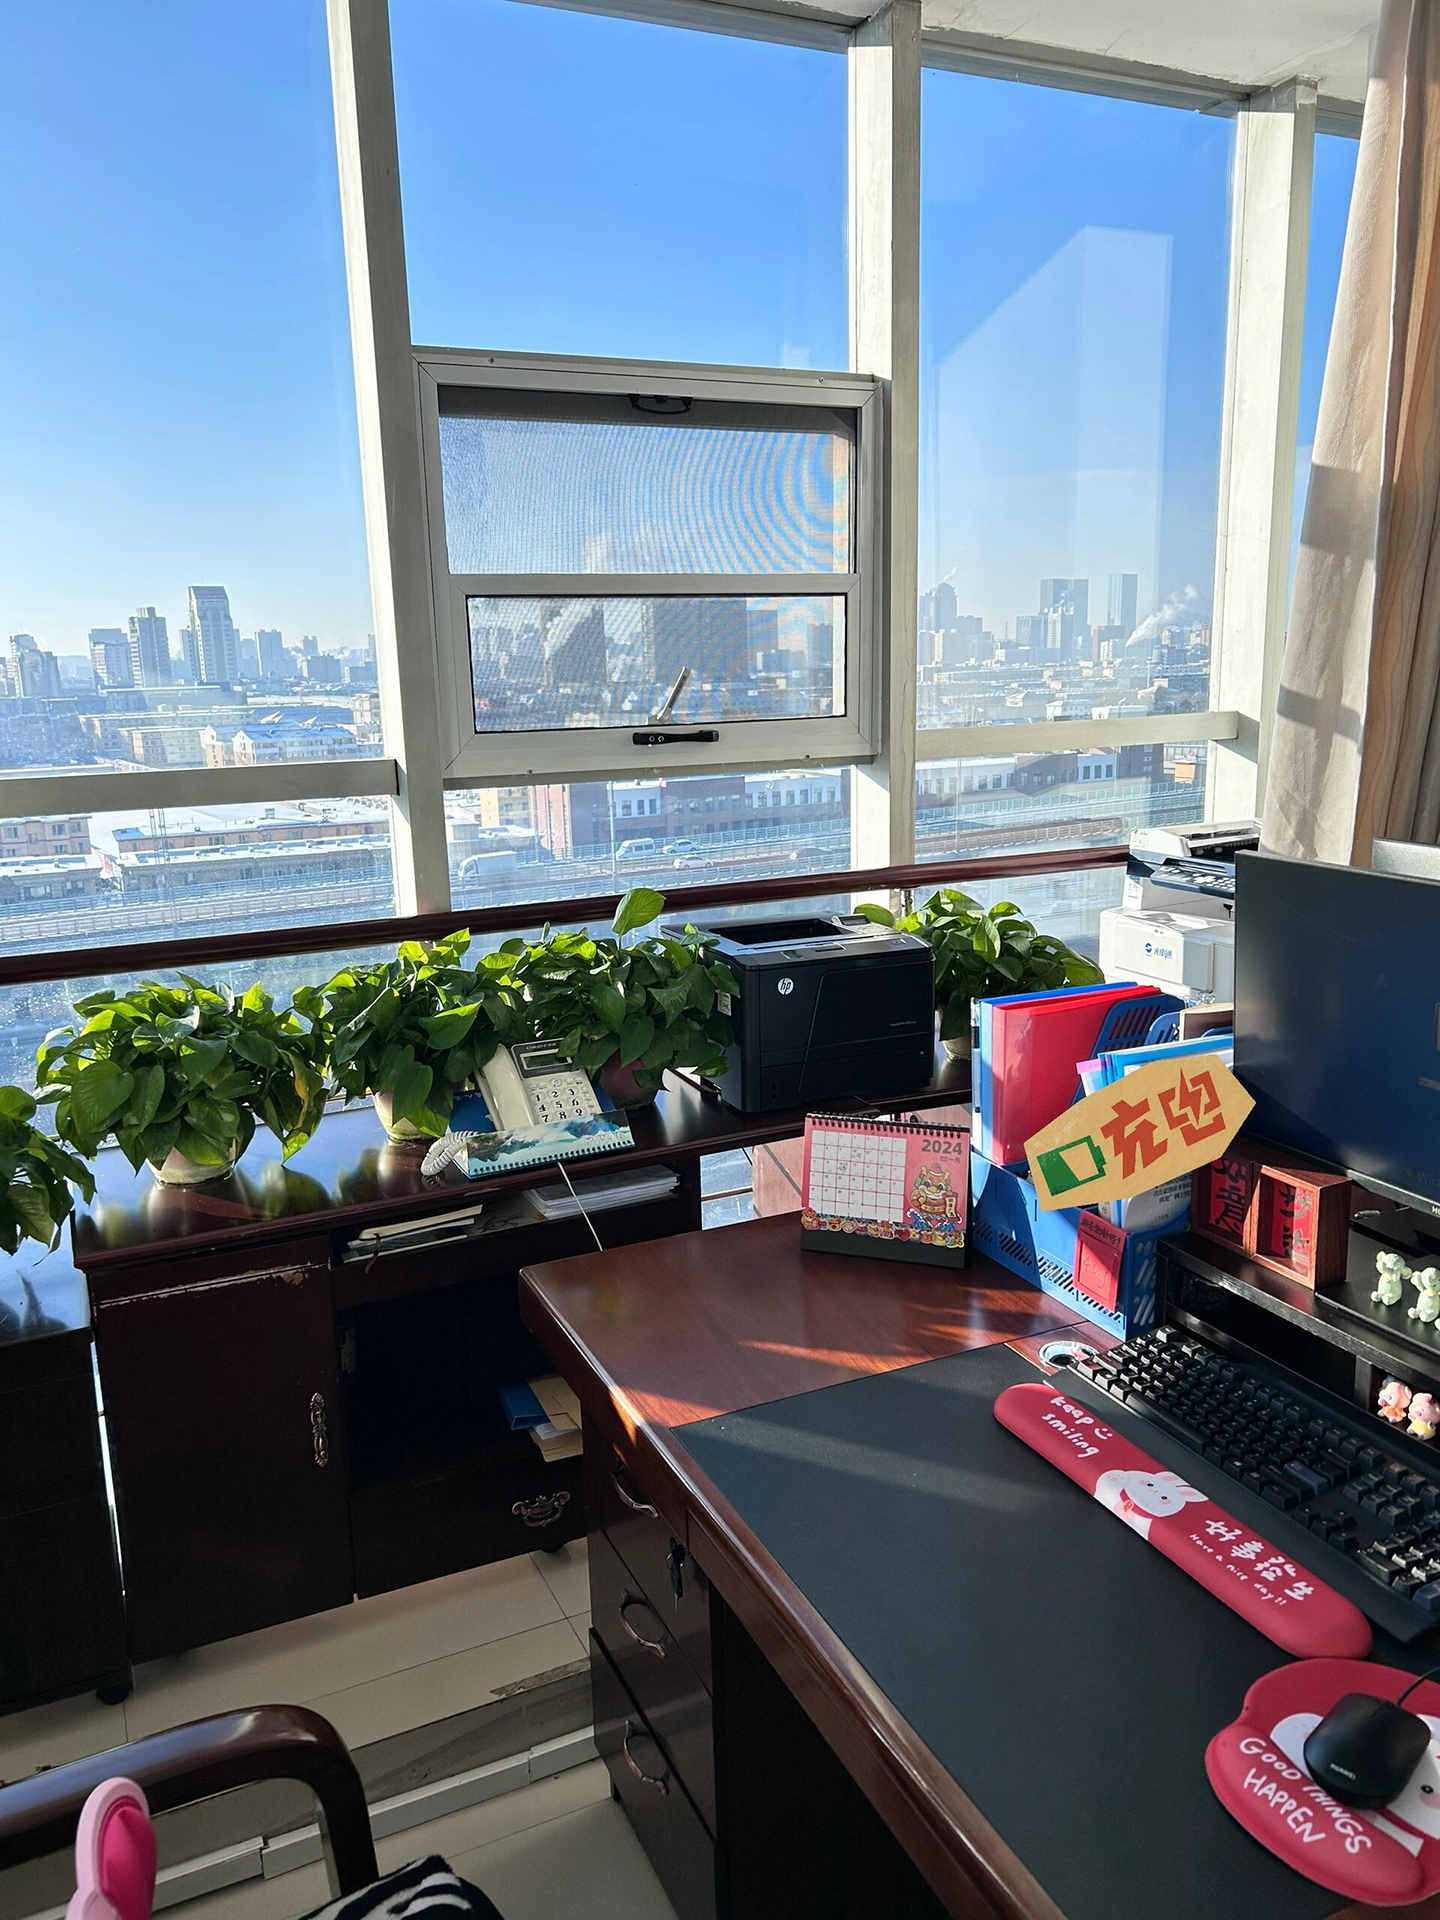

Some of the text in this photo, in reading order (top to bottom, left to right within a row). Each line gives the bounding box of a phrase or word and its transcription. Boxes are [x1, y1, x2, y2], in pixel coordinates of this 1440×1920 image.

[779, 977, 793, 996] hp
[921, 1139, 963, 1155] 2024
[1041, 1413, 1099, 1458] smiling
[1189, 1533, 1214, 1554] Have
[1226, 1564, 1248, 1580] nice
[1243, 1767, 1326, 1843] HAPPEN
[1302, 1785, 1372, 1854] THINGS
